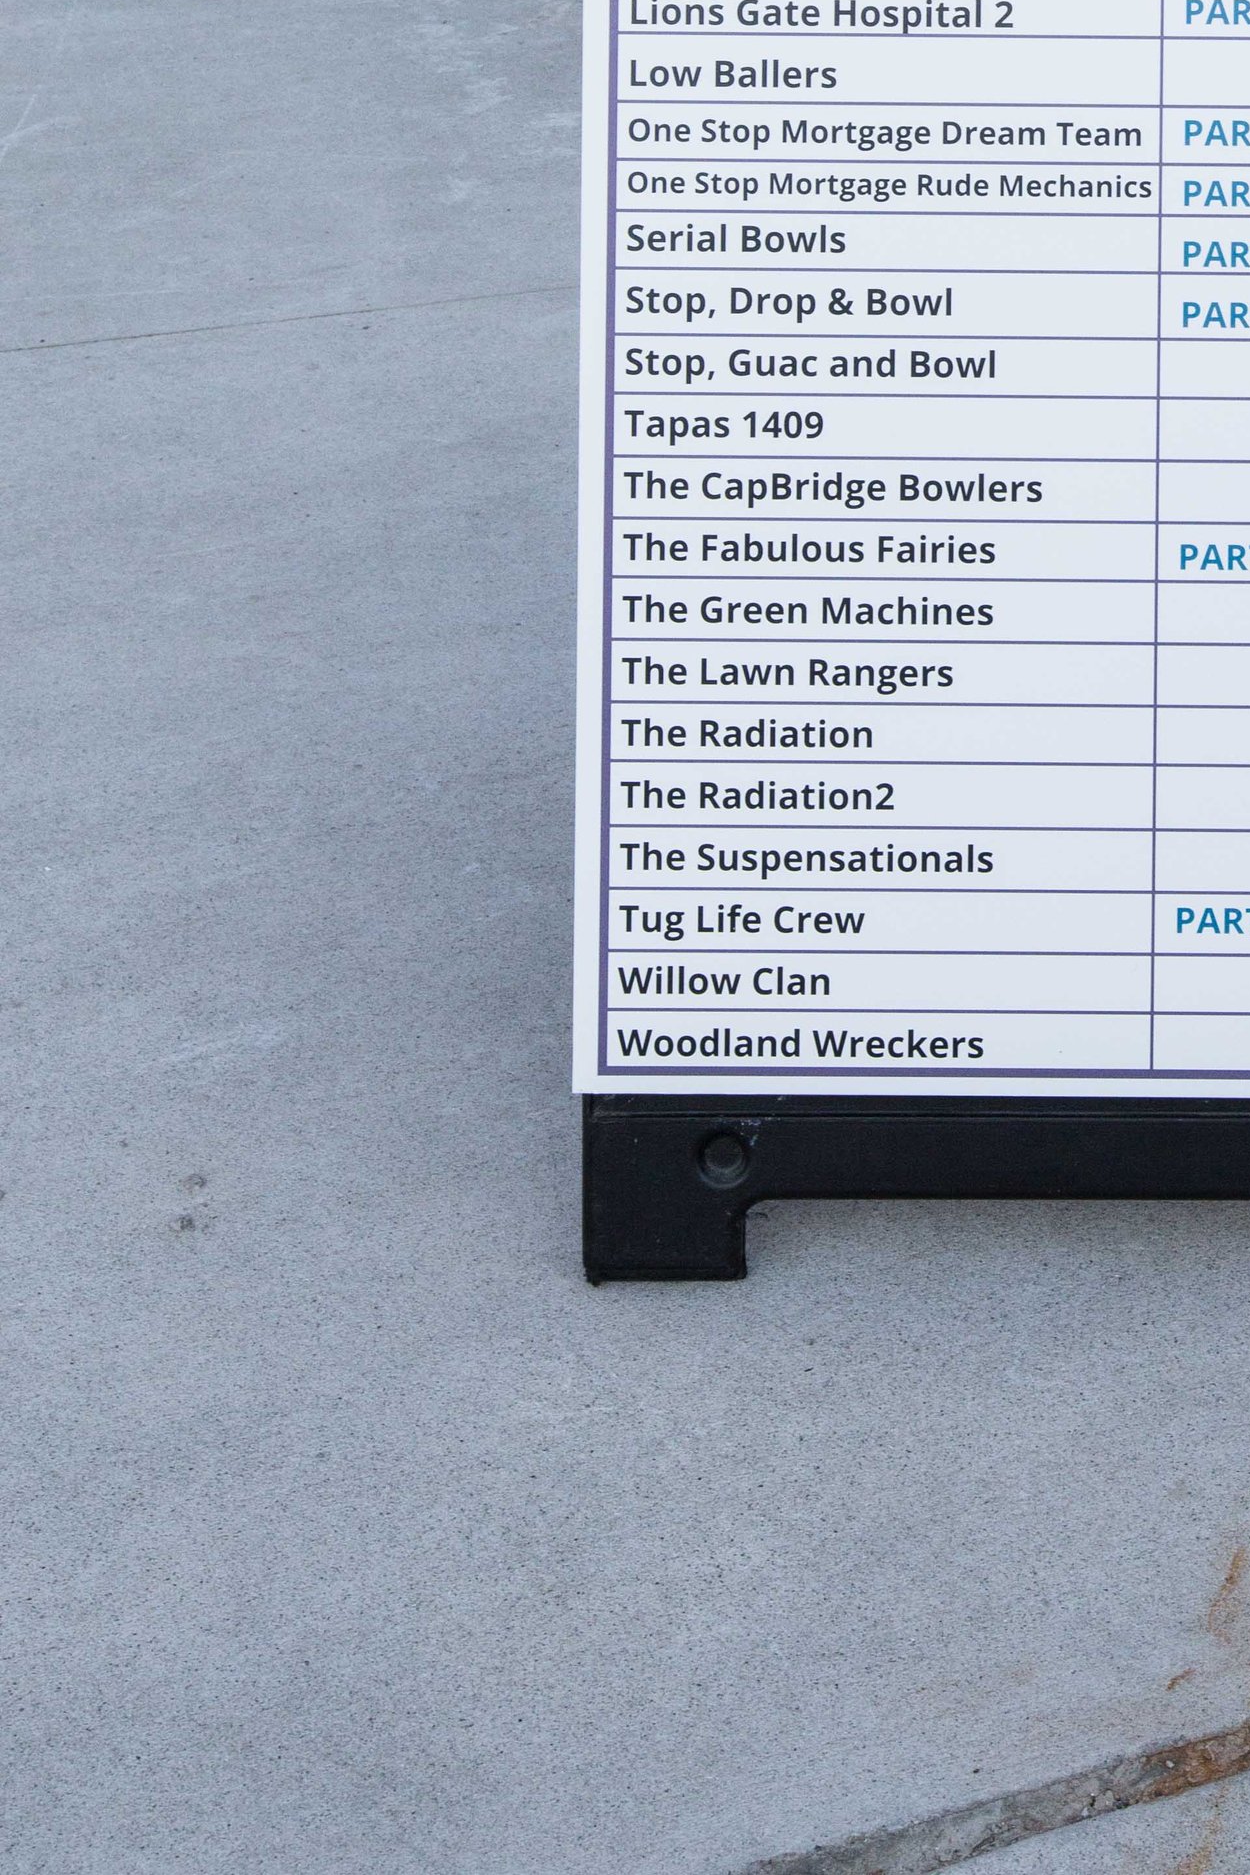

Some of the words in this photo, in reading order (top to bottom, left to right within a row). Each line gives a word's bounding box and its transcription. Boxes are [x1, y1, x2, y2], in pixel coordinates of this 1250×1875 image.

[833, 0, 982, 34] Hospital
[994, 0, 1014, 29] 2
[630, 59, 702, 88] Low
[714, 58, 837, 89] Ballers
[628, 117, 691, 143] One
[701, 118, 771, 151] Stop
[781, 119, 931, 152] Mortgage
[942, 120, 1046, 146] Dream
[1055, 122, 1142, 147] Team
[627, 171, 686, 194] One
[694, 171, 759, 202] Stop
[769, 172, 907, 203] Mortgage
[917, 173, 989, 197] Rude
[999, 173, 1152, 199] Mechanics
[626, 223, 727, 253] Serial
[741, 224, 846, 254] Bowls
[626, 285, 716, 323] Stop,
[730, 287, 816, 324] Drop
[827, 287, 854, 316] &
[866, 287, 952, 317] Bowl
[625, 347, 715, 385] Stop,
[728, 348, 818, 378] Guac
[829, 348, 896, 378] and
[910, 349, 996, 379] Bowl
[623, 409, 730, 447] Tapas
[742, 410, 824, 439] 1409
[623, 470, 689, 500] The
[701, 471, 887, 510] CapBridge
[899, 472, 1043, 503] Bowlers
[622, 532, 689, 562] The
[701, 532, 865, 563] Fabulous
[877, 535, 996, 565] Fairies
[621, 593, 688, 624] The
[700, 595, 808, 625] Green
[821, 595, 994, 626] Machines
[621, 655, 688, 686] The
[700, 657, 795, 686] Lawn
[809, 658, 954, 696] Rangers
[620, 717, 687, 748] The
[700, 718, 873, 749] Radiation
[620, 779, 687, 810] The
[699, 780, 895, 811] Radiation2
[619, 841, 686, 872] The
[697, 843, 994, 881] Suspensationals
[618, 904, 686, 942] Tug
[697, 903, 762, 934] Life
[773, 905, 866, 934] Crew
[617, 965, 742, 995] Willow
[752, 965, 830, 996] Clan
[617, 1027, 801, 1058] Woodland
[812, 1028, 984, 1059] Wreckers
